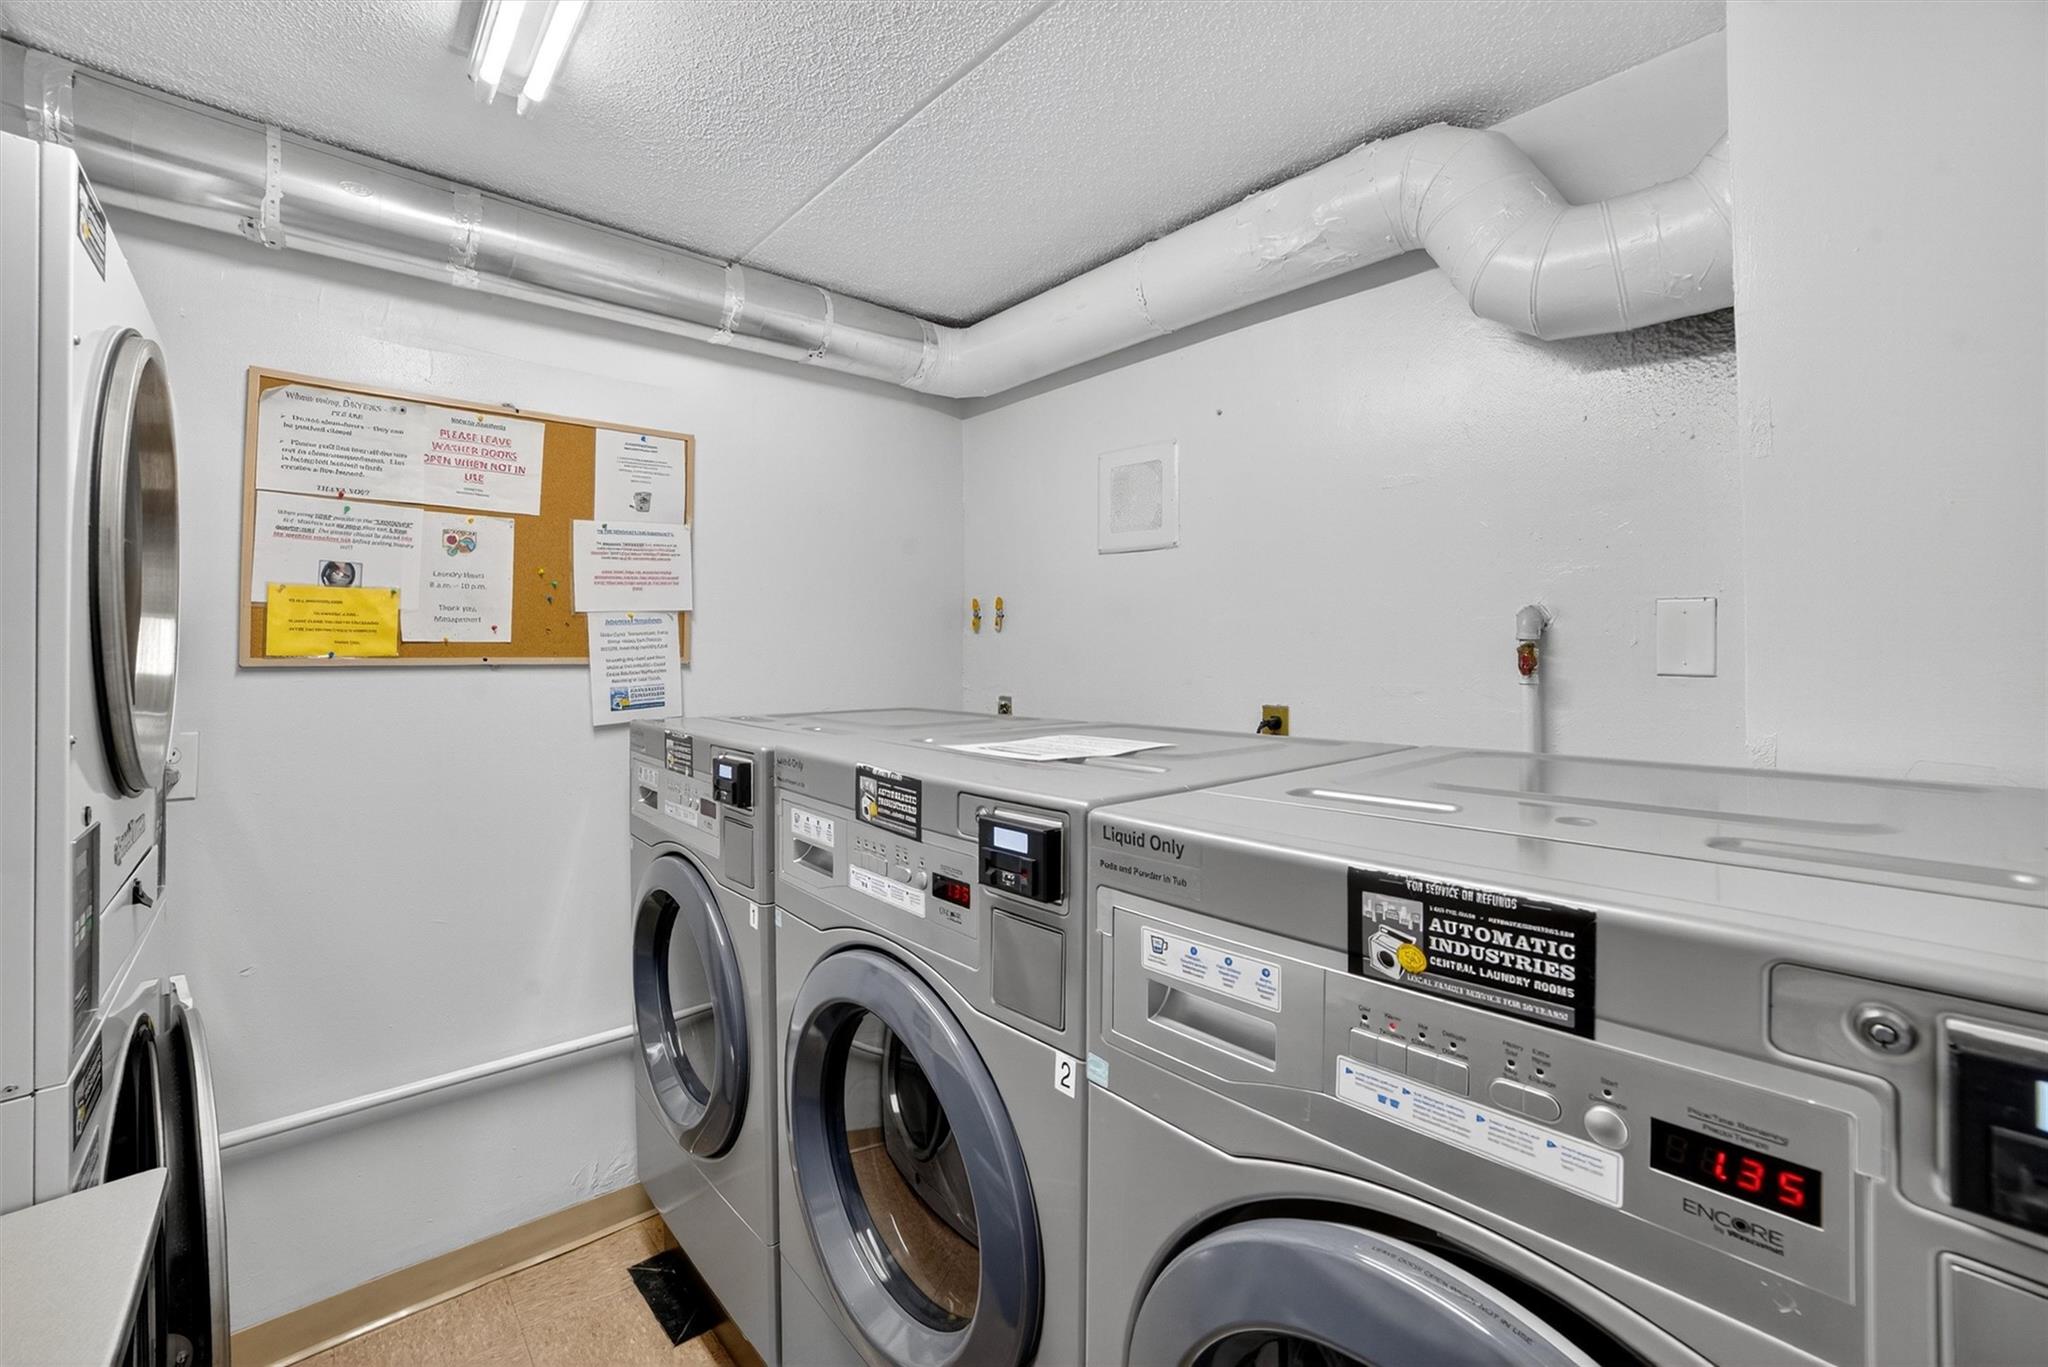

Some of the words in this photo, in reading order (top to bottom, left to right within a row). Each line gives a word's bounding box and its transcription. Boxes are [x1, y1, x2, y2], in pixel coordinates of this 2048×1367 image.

[431, 441, 479, 455] WASHER
[481, 448, 518, 461] DOORS
[440, 428, 478, 441] PLEASE
[480, 434, 512, 447] LEAVE
[454, 457, 488, 470] WHEN
[490, 462, 512, 473] NOT
[514, 465, 526, 475] IN
[464, 473, 485, 482] USE
[433, 570, 461, 579] Laundry
[463, 571, 485, 580] Hours
[460, 582, 470, 590] 10
[433, 615, 482, 624] Management
[439, 604, 460, 612] Thank
[1102, 824, 1145, 848] Liquid
[1150, 834, 1185, 860] Only
[1099, 859, 1118, 871] Pods
[1118, 863, 1133, 875] and
[1163, 873, 1171, 882] in
[1172, 875, 1188, 888] Tub
[1406, 879, 1424, 893] FOR
[1426, 883, 1460, 900] SERVICE
[1461, 889, 1474, 902] OR
[1475, 891, 1518, 910] REFUNDS
[1428, 917, 1576, 960] AUTOMATIC
[1429, 936, 1576, 982] INDUSTRIES
[1407, 973, 1433, 987] LOCAL
[1502, 996, 1522, 1009] FOR
[1429, 957, 1477, 976] CENTRAL
[1480, 964, 1532, 989] LAUNDRY
[1534, 979, 1575, 999] ROOMS
[1060, 1061, 1071, 1089] 2
[1682, 1197, 1785, 1250] ENCORE
[1423, 1270, 1449, 1288] OPEN
[1500, 1318, 1512, 1330] IN
[1512, 1326, 1535, 1346] USE
